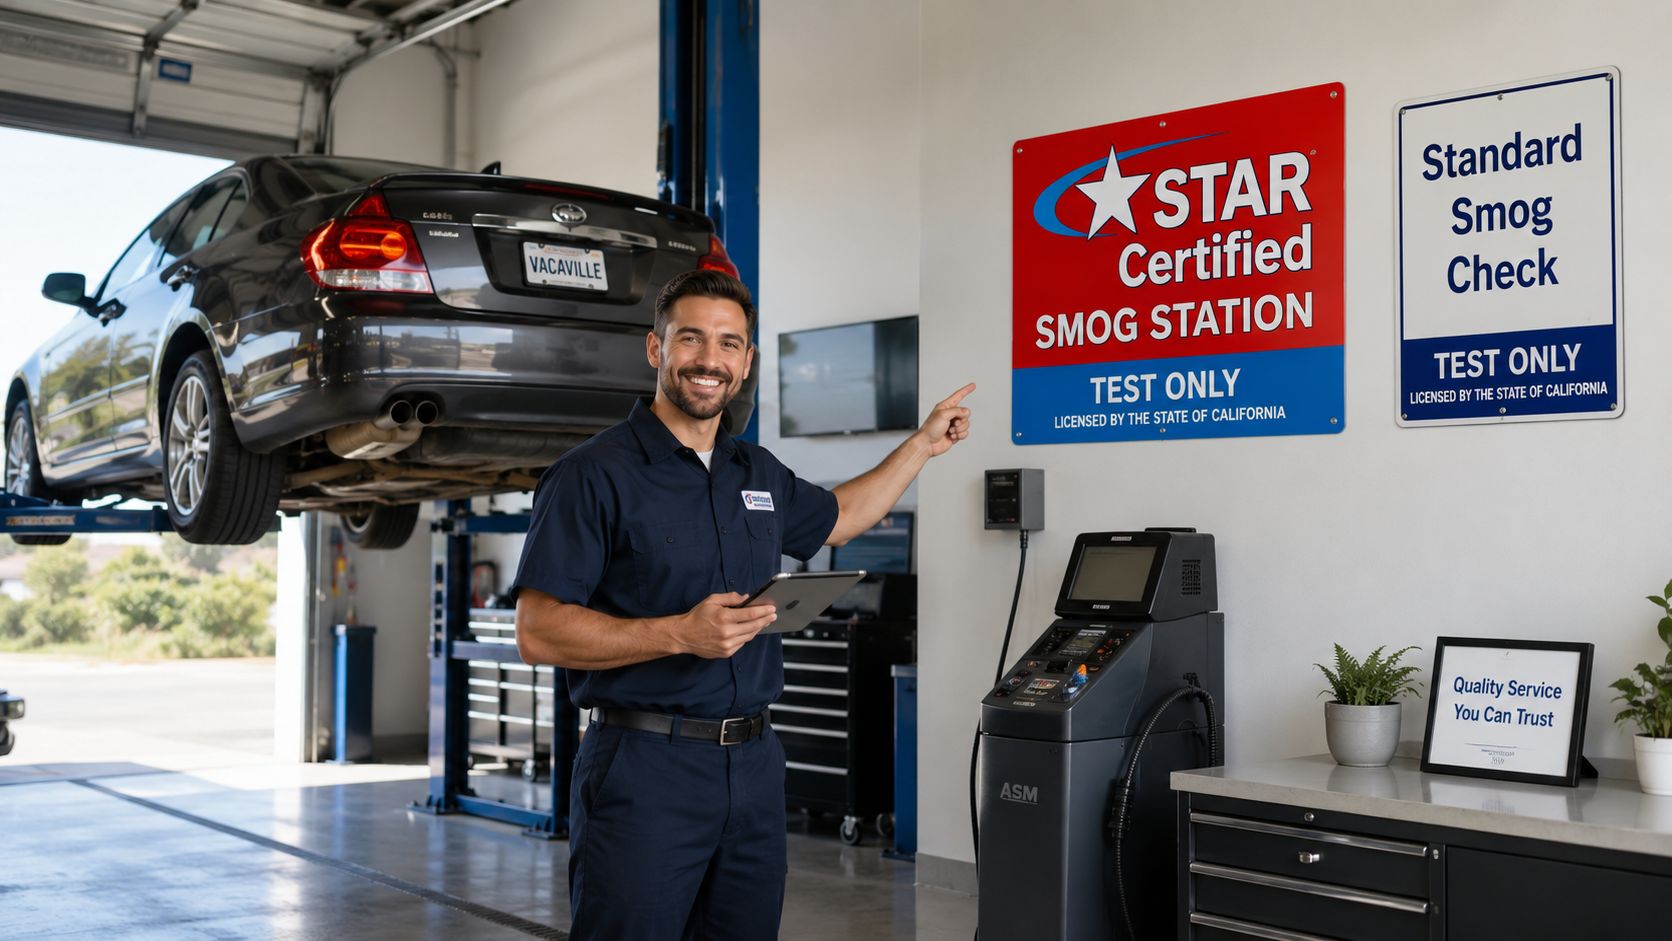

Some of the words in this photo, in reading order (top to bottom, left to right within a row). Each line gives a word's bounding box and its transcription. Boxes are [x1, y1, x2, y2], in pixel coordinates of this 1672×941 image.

[1421, 122, 1582, 181] Standard
[1153, 151, 1313, 229] STAR
[1451, 196, 1554, 236] Smog
[529, 255, 602, 280] VACAVILLE
[1118, 222, 1313, 288] Certified
[1447, 247, 1559, 294] Check
[1035, 306, 1138, 350] SMOG
[1150, 291, 1314, 341] STATION
[1433, 348, 1500, 380] TEST
[1508, 343, 1582, 375] ONLY
[1090, 373, 1157, 405] TEST
[1164, 368, 1241, 401] ONLY
[1410, 389, 1457, 404] LICENSED
[1459, 388, 1473, 402] BY
[1474, 388, 1494, 401] THE
[1496, 386, 1527, 400] STATE
[1529, 385, 1543, 398] OF
[1545, 381, 1608, 397] CALIFORNIA
[1054, 413, 1107, 429] LICENSED
[1110, 412, 1125, 426] BY
[1127, 411, 1150, 426] THE
[1153, 410, 1189, 425] STATE
[1192, 409, 1208, 422] OF
[1211, 405, 1287, 422] CALIFORNIA
[1453, 676, 1504, 699] Quality
[1507, 679, 1563, 700] Service
[1454, 703, 1479, 722] You
[1484, 706, 1511, 725] Can
[1516, 708, 1554, 727] Trust
[1000, 782, 1039, 803] ASM
